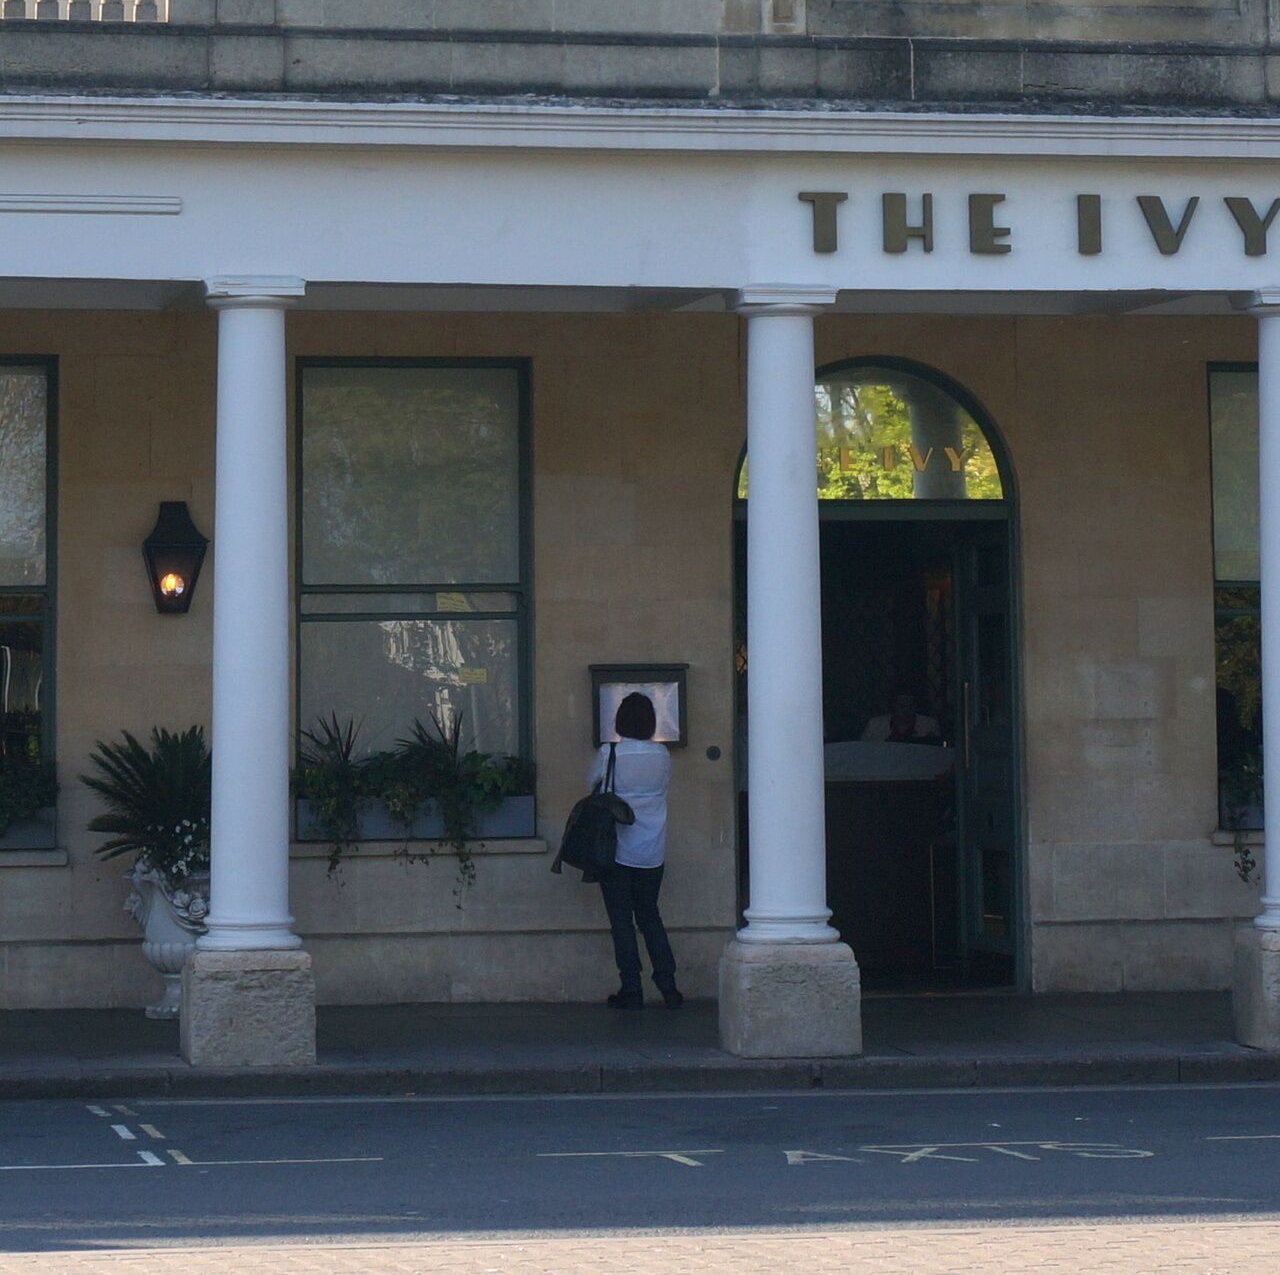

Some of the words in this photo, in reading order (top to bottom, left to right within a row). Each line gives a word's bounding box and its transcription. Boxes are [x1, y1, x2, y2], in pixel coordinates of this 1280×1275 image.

[798, 192, 1011, 254] THE
[883, 446, 971, 472] IVY
[625, 1143, 1154, 1166] TAXIS
